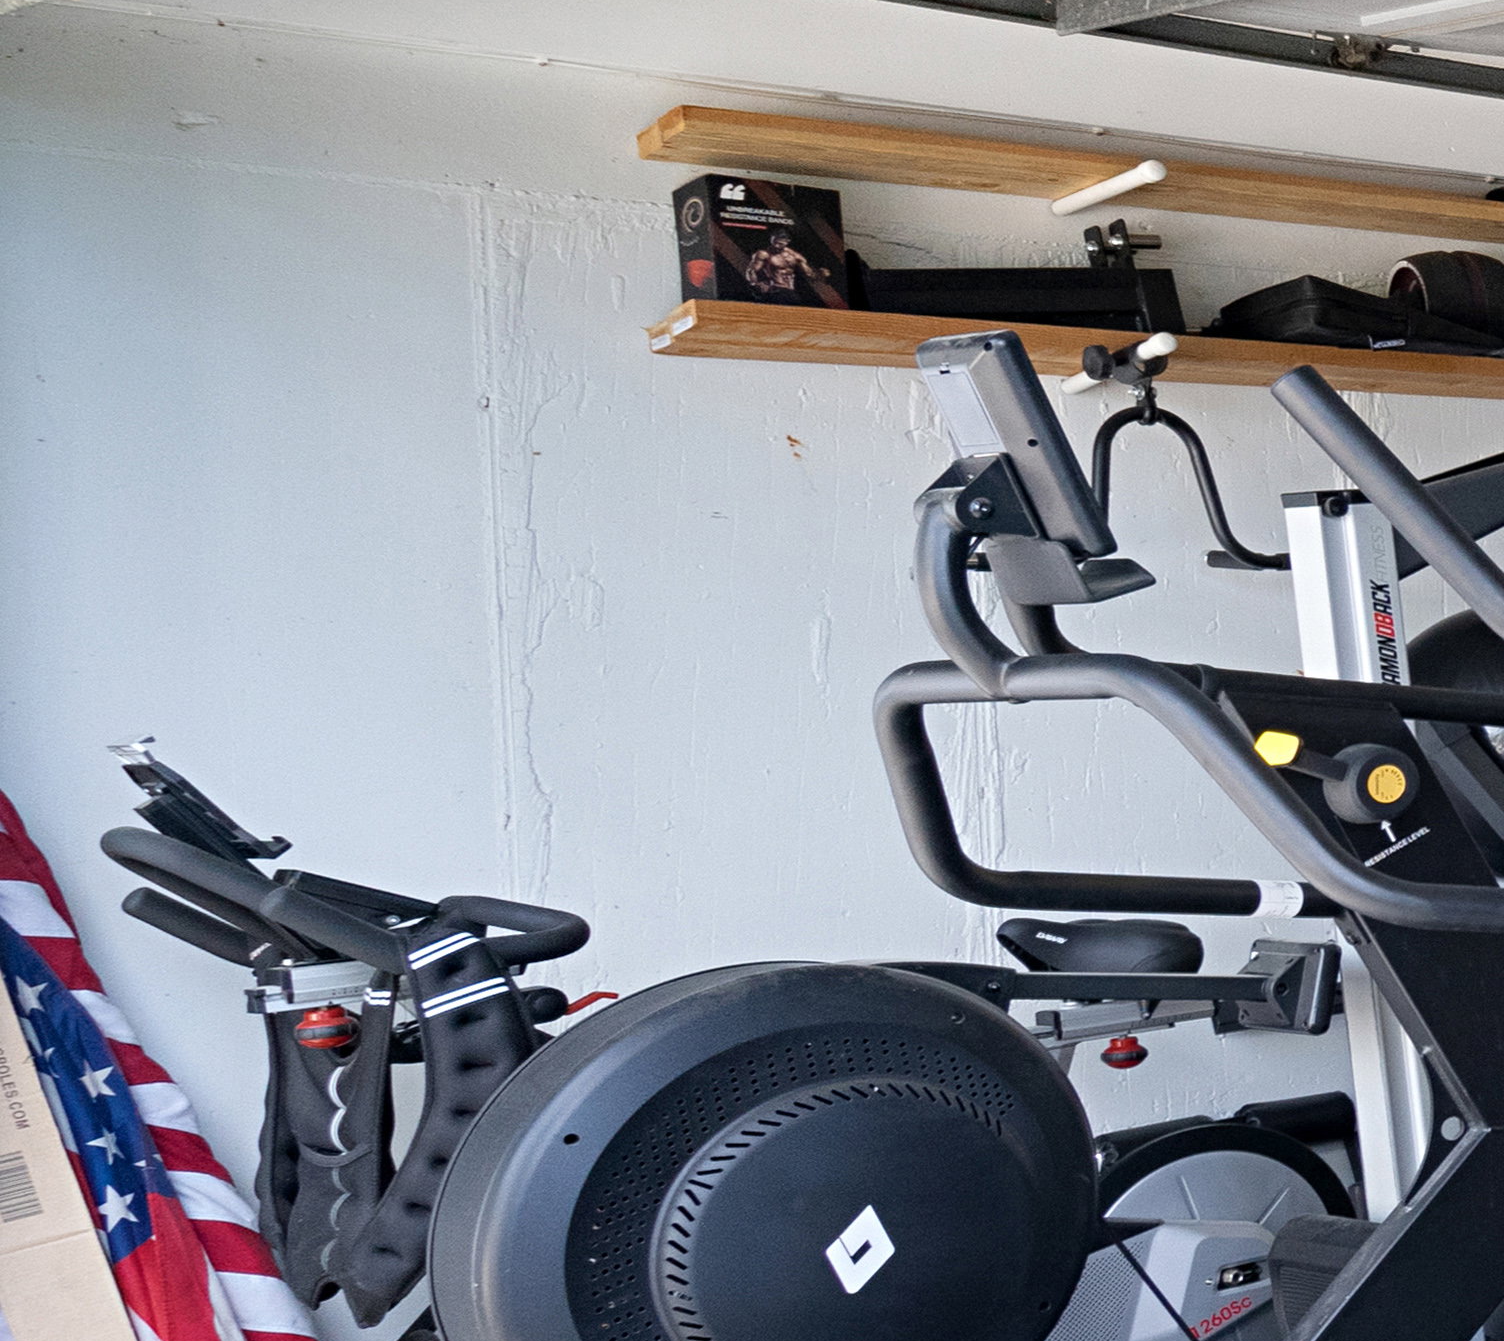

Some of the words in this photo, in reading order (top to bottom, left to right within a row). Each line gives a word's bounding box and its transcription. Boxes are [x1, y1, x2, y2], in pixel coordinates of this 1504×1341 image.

[1369, 579, 1402, 687] AMONDBACK
[1364, 838, 1409, 867] RESISTANCE
[1407, 826, 1431, 844] LEVEL
